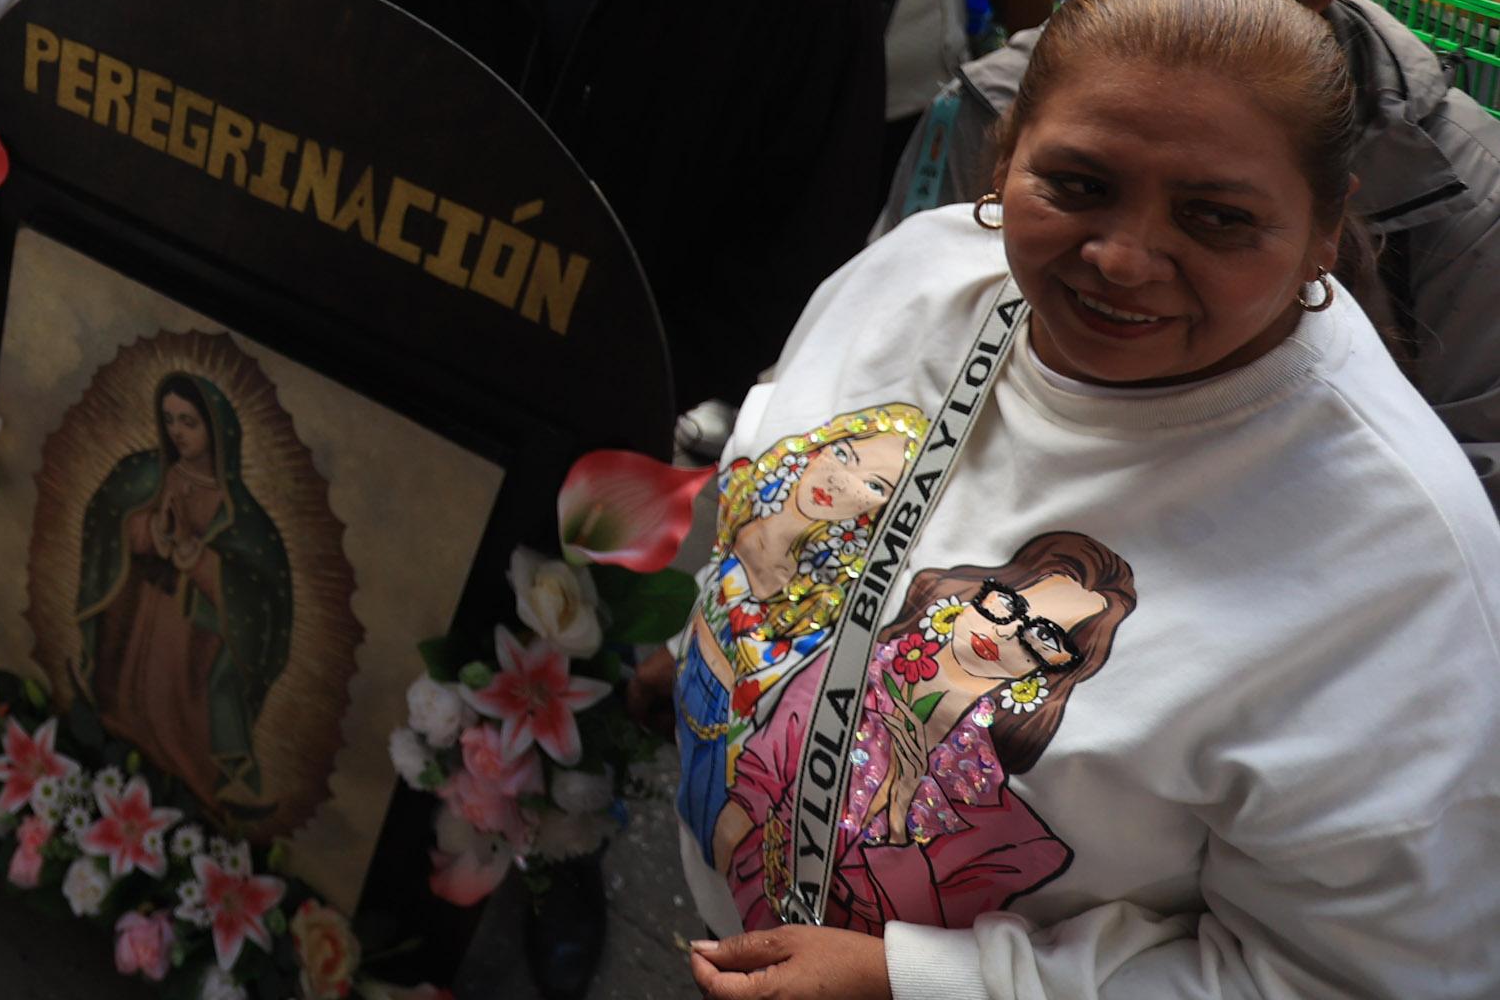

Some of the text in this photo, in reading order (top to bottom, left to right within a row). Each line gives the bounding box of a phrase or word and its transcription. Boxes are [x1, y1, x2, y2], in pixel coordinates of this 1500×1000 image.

[23, 22, 590, 336] PEREGRINACIÓN
[851, 298, 1025, 632] BIMBA Y LOLA
[799, 820, 825, 861] Y
[802, 688, 856, 825] LOLA
